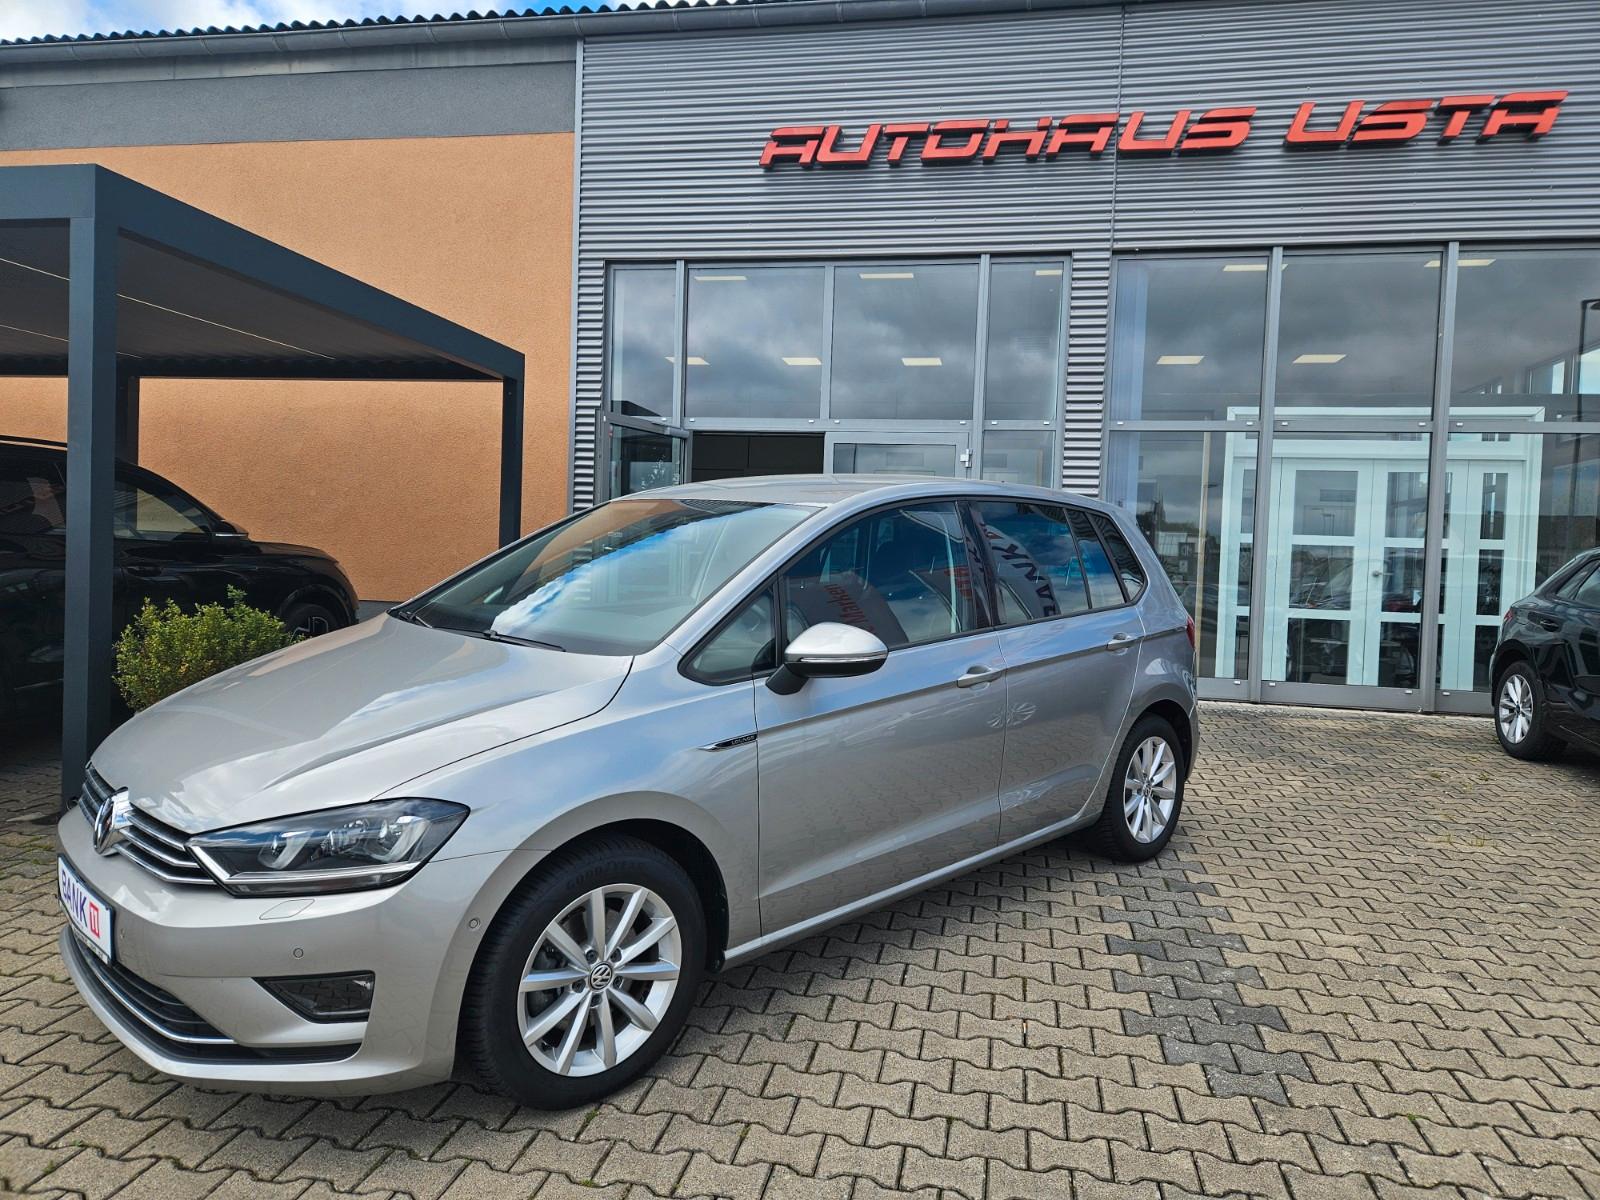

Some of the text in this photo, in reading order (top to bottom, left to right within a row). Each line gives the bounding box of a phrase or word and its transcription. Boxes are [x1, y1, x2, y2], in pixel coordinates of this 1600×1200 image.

[758, 91, 1569, 169] AUTOHAUS USTA
[61, 869, 87, 927] BANK
